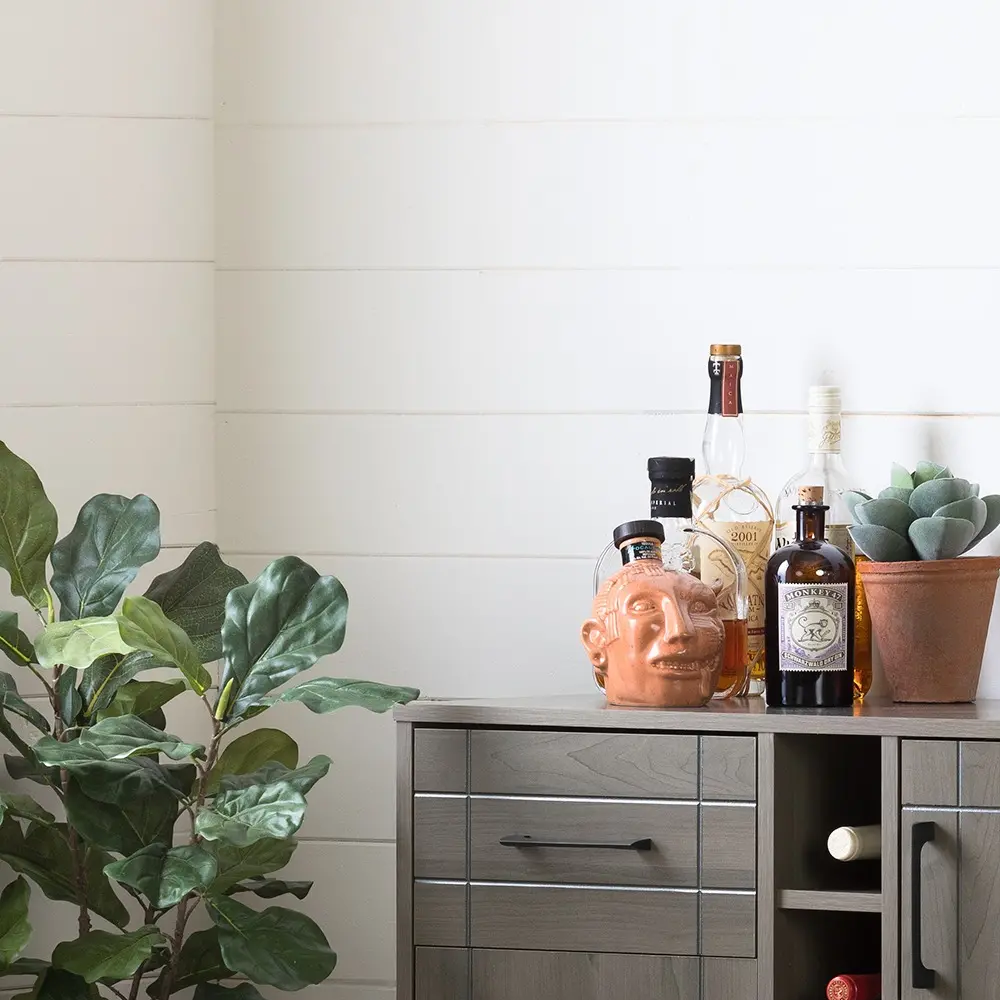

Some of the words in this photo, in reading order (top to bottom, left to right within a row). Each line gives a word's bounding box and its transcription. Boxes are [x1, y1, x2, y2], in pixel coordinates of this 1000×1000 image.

[731, 531, 757, 542] 2001
[786, 589, 830, 601] MONKEY
[831, 592, 842, 600] 47
